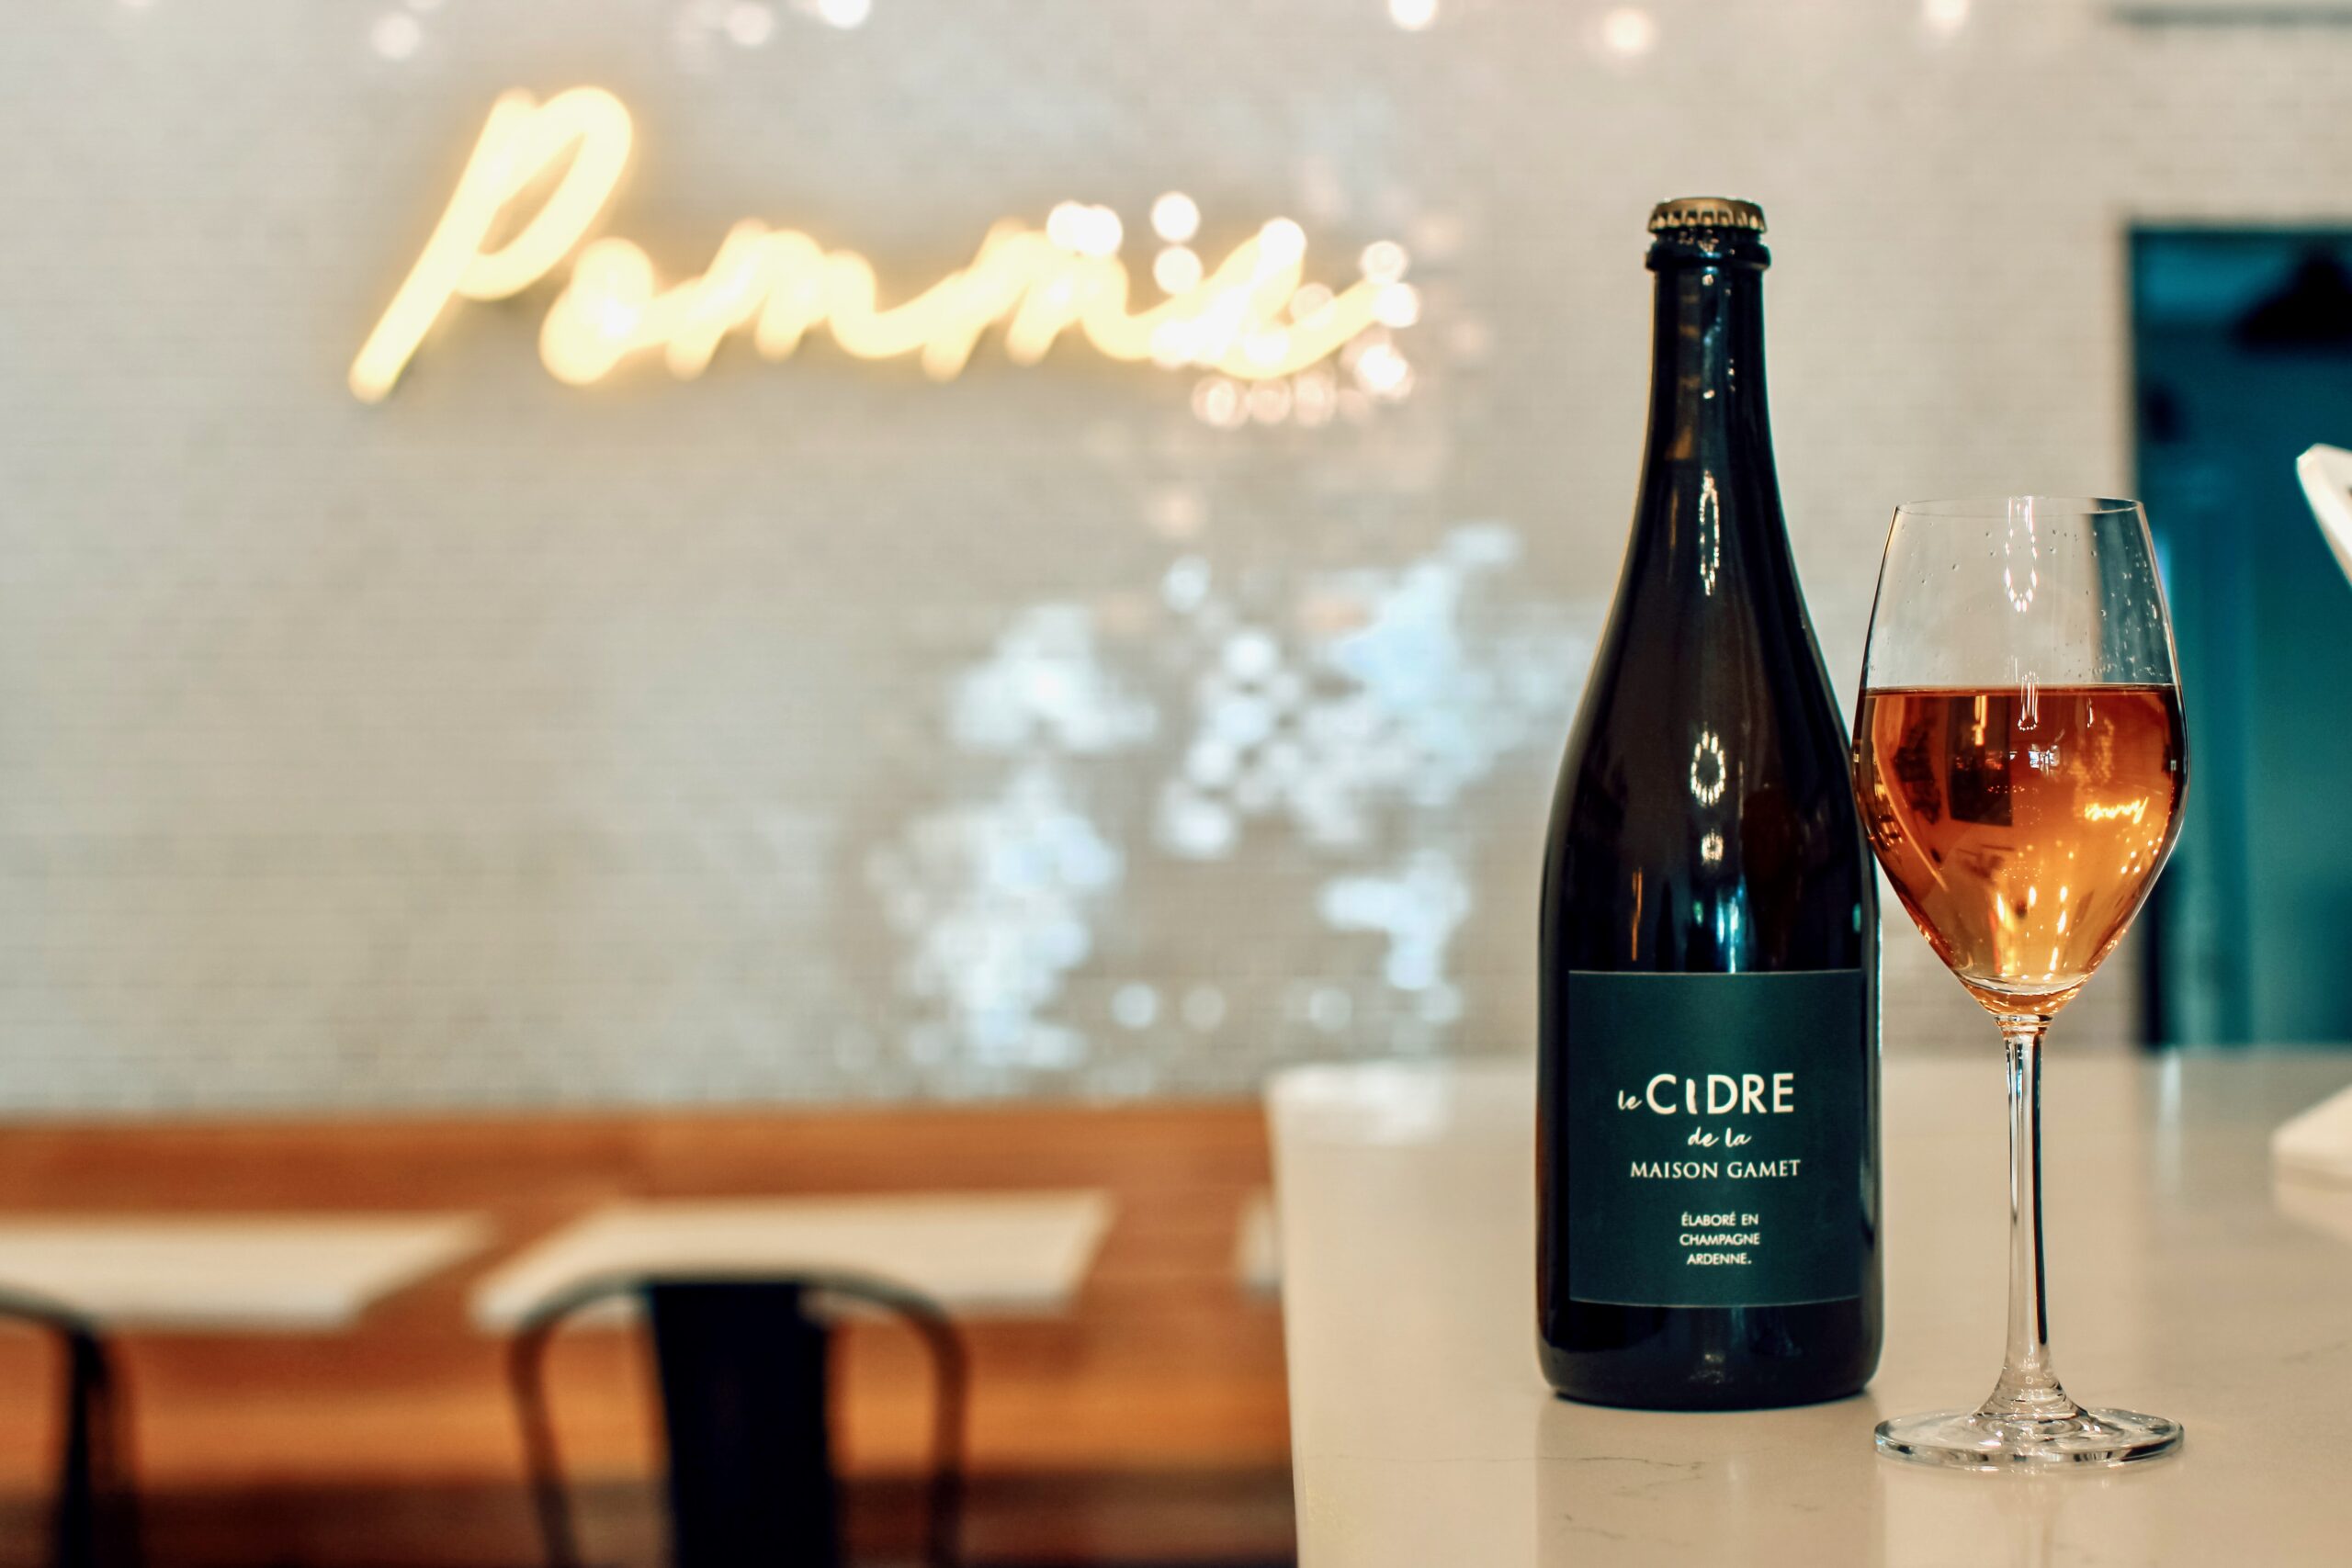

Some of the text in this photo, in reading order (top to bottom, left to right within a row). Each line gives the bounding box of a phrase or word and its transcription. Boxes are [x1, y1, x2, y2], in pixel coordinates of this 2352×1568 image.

[1617, 1073, 1793, 1114] le CIDRE
[1687, 1126, 1752, 1148] de la
[1630, 1159, 1801, 1179] MAISON GAMET
[1681, 1211, 1758, 1227] ÉLABORÉ EN
[1679, 1233, 1760, 1247] CHAMPAGNE
[1687, 1252, 1751, 1266] ARDENNE.
